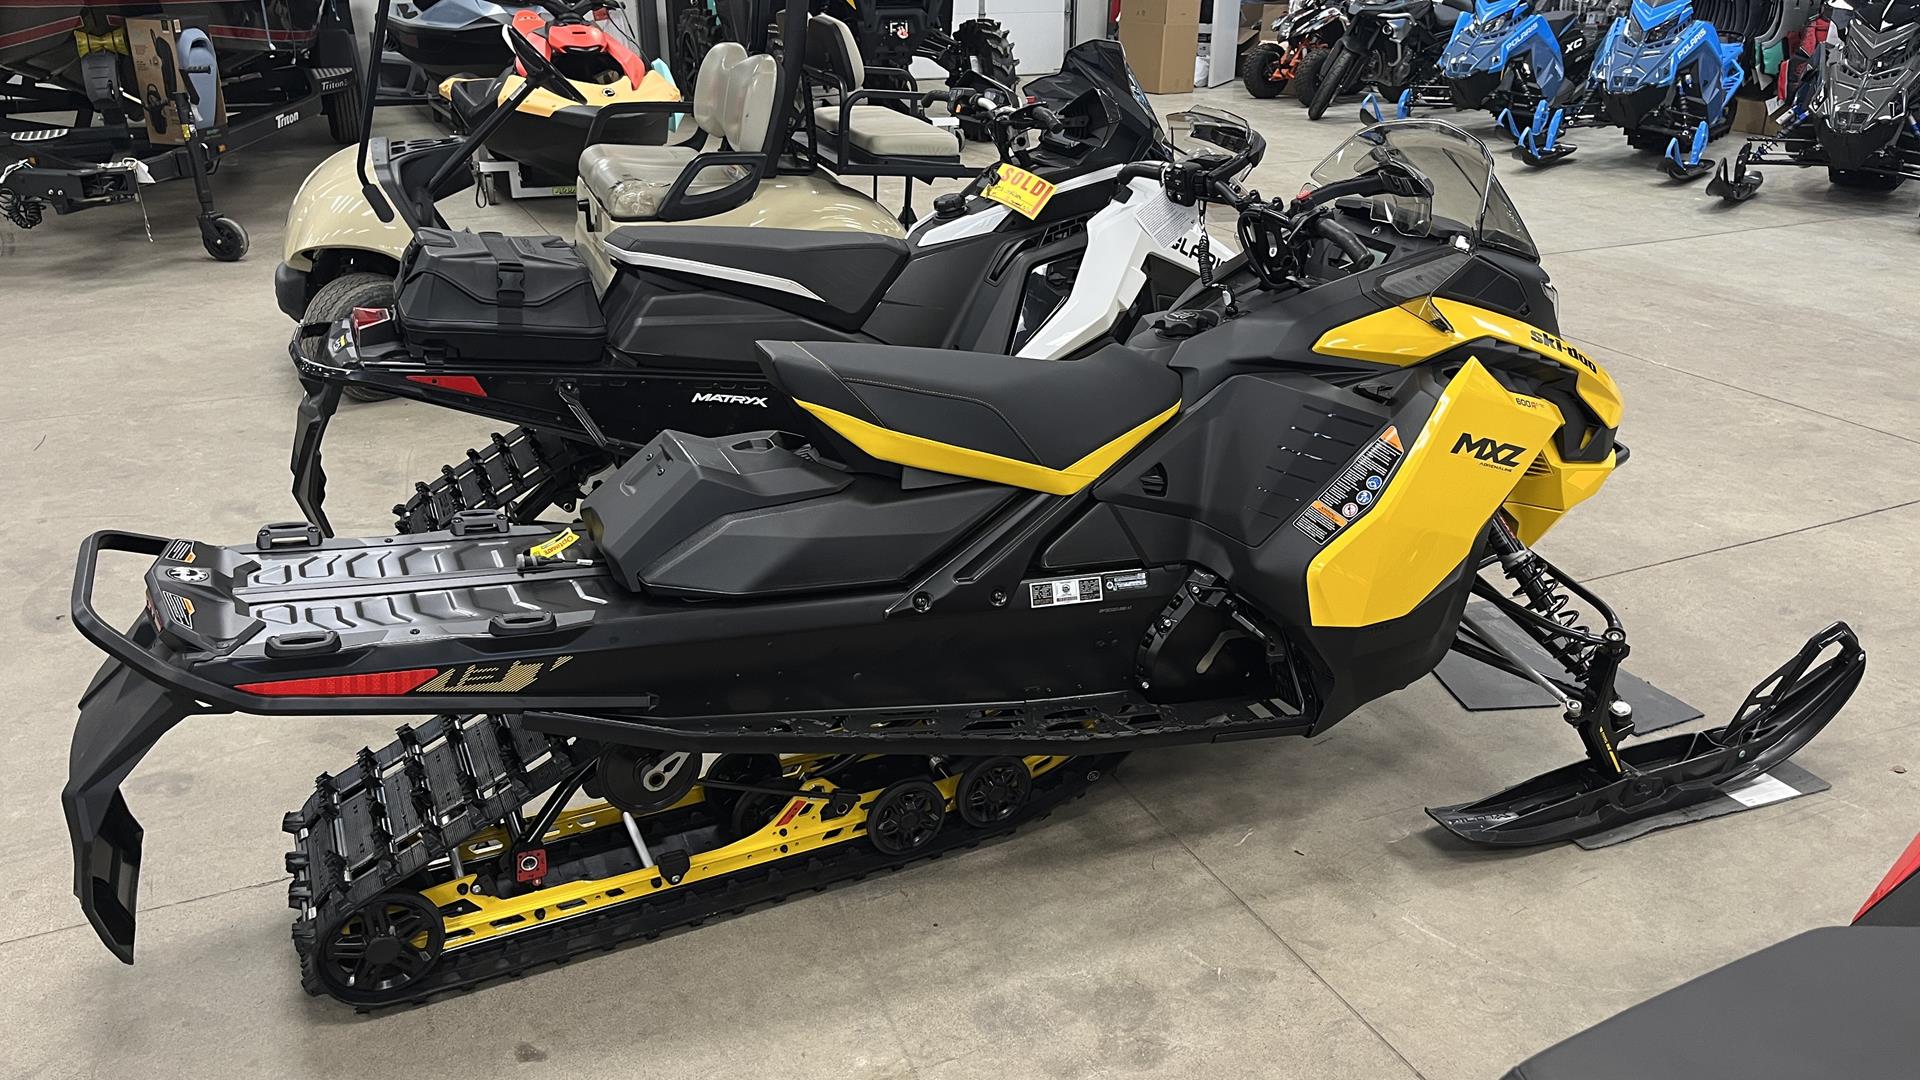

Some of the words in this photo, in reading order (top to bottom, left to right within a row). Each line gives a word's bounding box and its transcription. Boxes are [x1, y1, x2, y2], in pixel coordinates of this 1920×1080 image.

[1506, 22, 1539, 50] POLARIS
[1677, 28, 1706, 60] POLARIS
[1565, 38, 1584, 54] XC
[321, 80, 344, 91] Triton
[275, 112, 299, 129] Triton
[691, 393, 769, 408] MATRYX
[1450, 432, 1527, 468] MXZ
